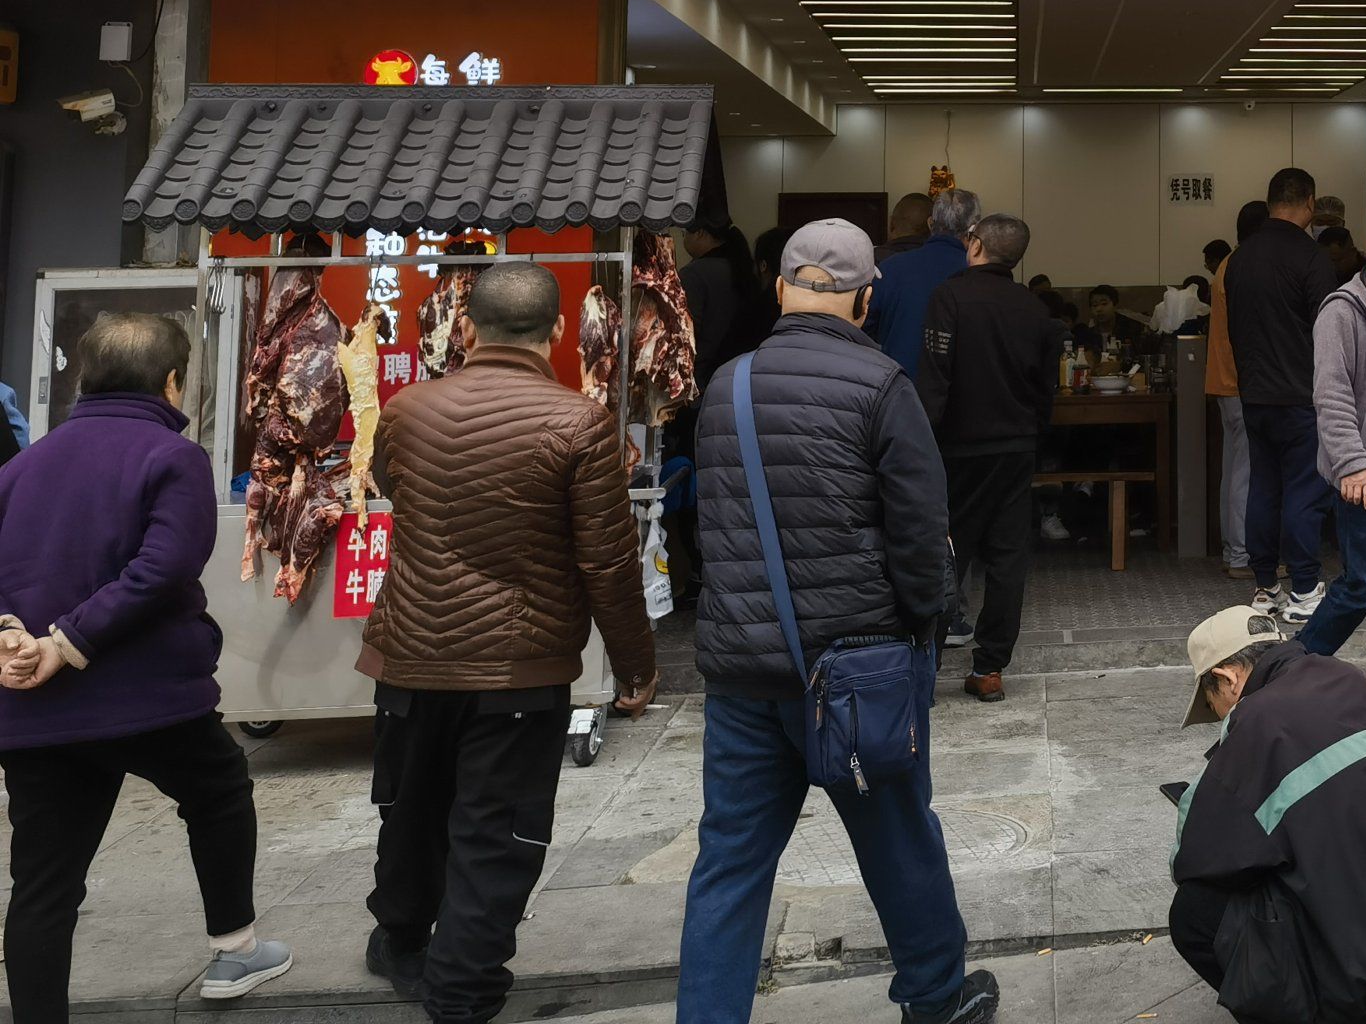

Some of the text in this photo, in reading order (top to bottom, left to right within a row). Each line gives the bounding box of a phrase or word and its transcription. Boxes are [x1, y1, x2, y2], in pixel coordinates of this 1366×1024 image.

[1169, 177, 1213, 202] 凭号取餐
[347, 524, 388, 562] 牛肉
